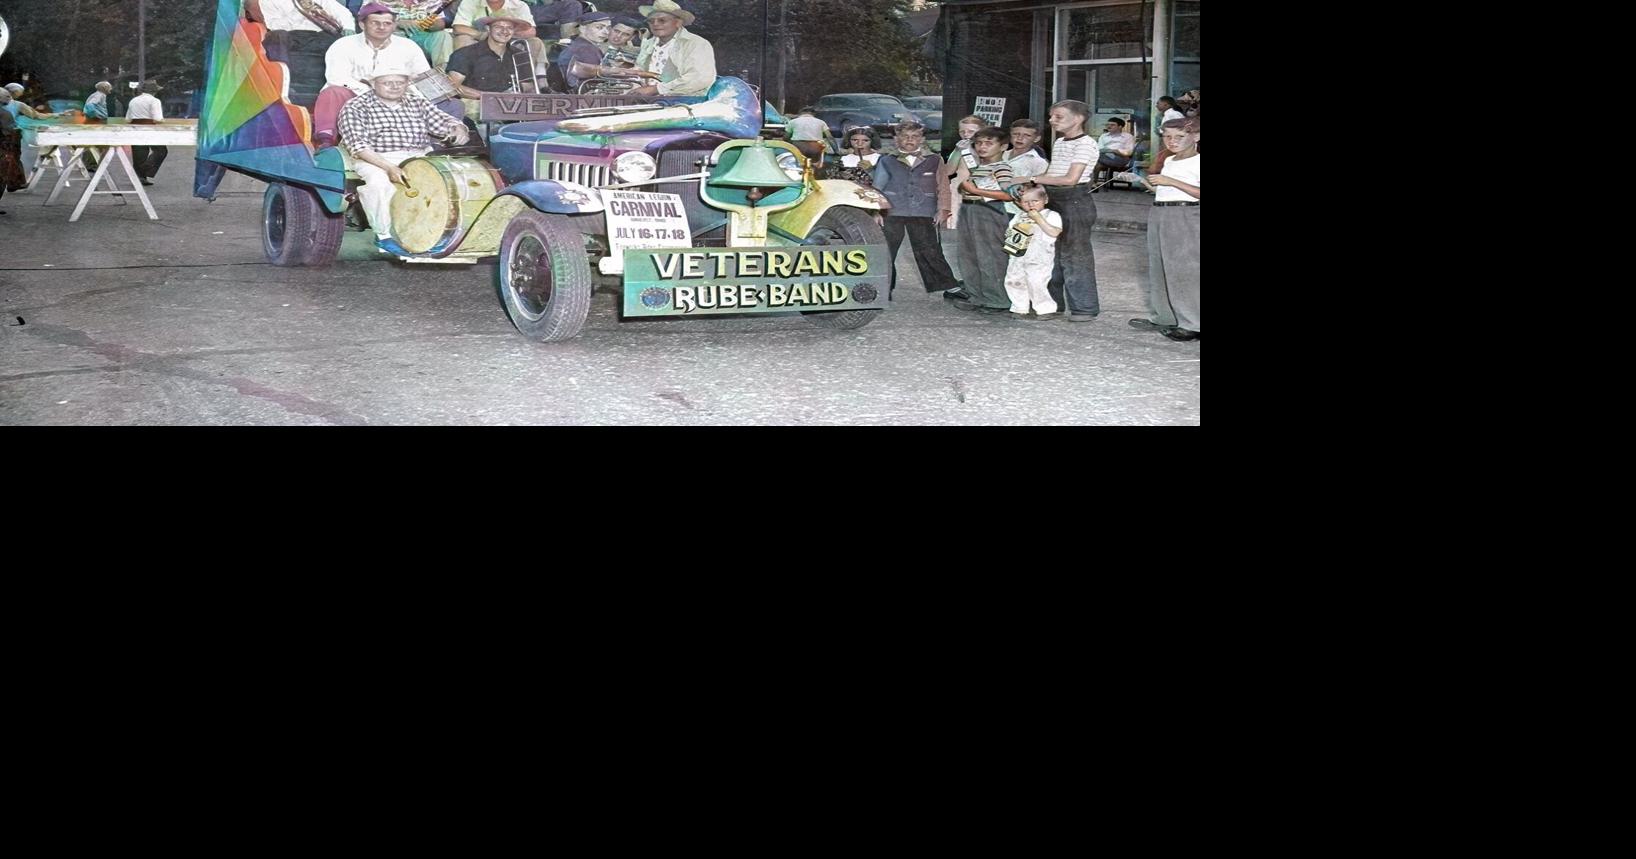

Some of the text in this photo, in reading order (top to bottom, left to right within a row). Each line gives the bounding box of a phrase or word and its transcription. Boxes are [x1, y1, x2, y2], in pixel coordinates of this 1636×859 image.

[976, 105, 1003, 113] PARKING
[613, 192, 646, 200] AMERICAN
[610, 200, 682, 218] CARNIVAL
[615, 228, 636, 239] JULY
[650, 249, 868, 280] VETERANS
[673, 281, 849, 313] RUBE BAND
